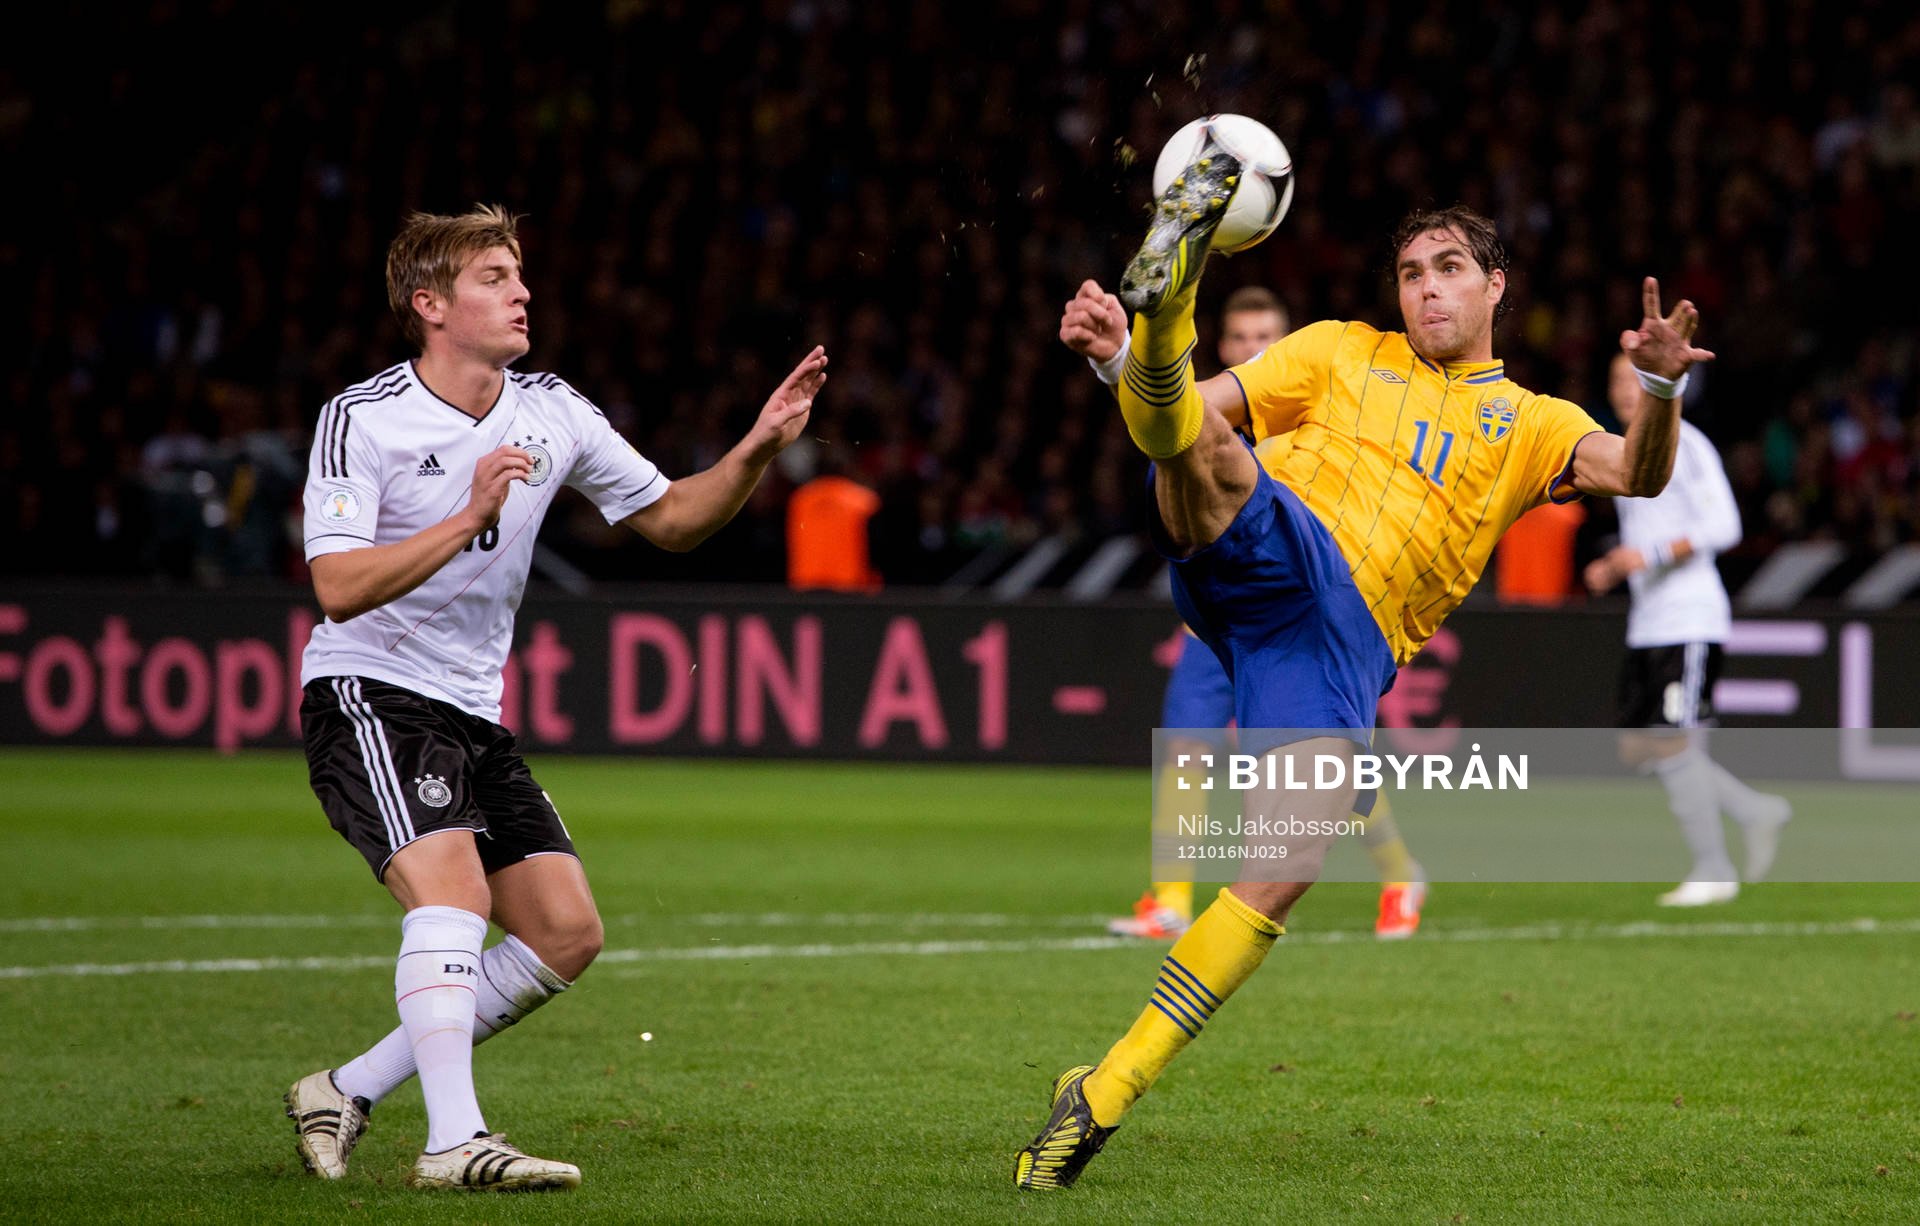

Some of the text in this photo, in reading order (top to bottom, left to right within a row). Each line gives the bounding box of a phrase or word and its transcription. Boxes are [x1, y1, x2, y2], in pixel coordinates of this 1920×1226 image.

[416, 467, 446, 477] adidas
[1406, 420, 1455, 487] 11
[463, 516, 500, 552] 8
[609, 612, 822, 746] DIN
